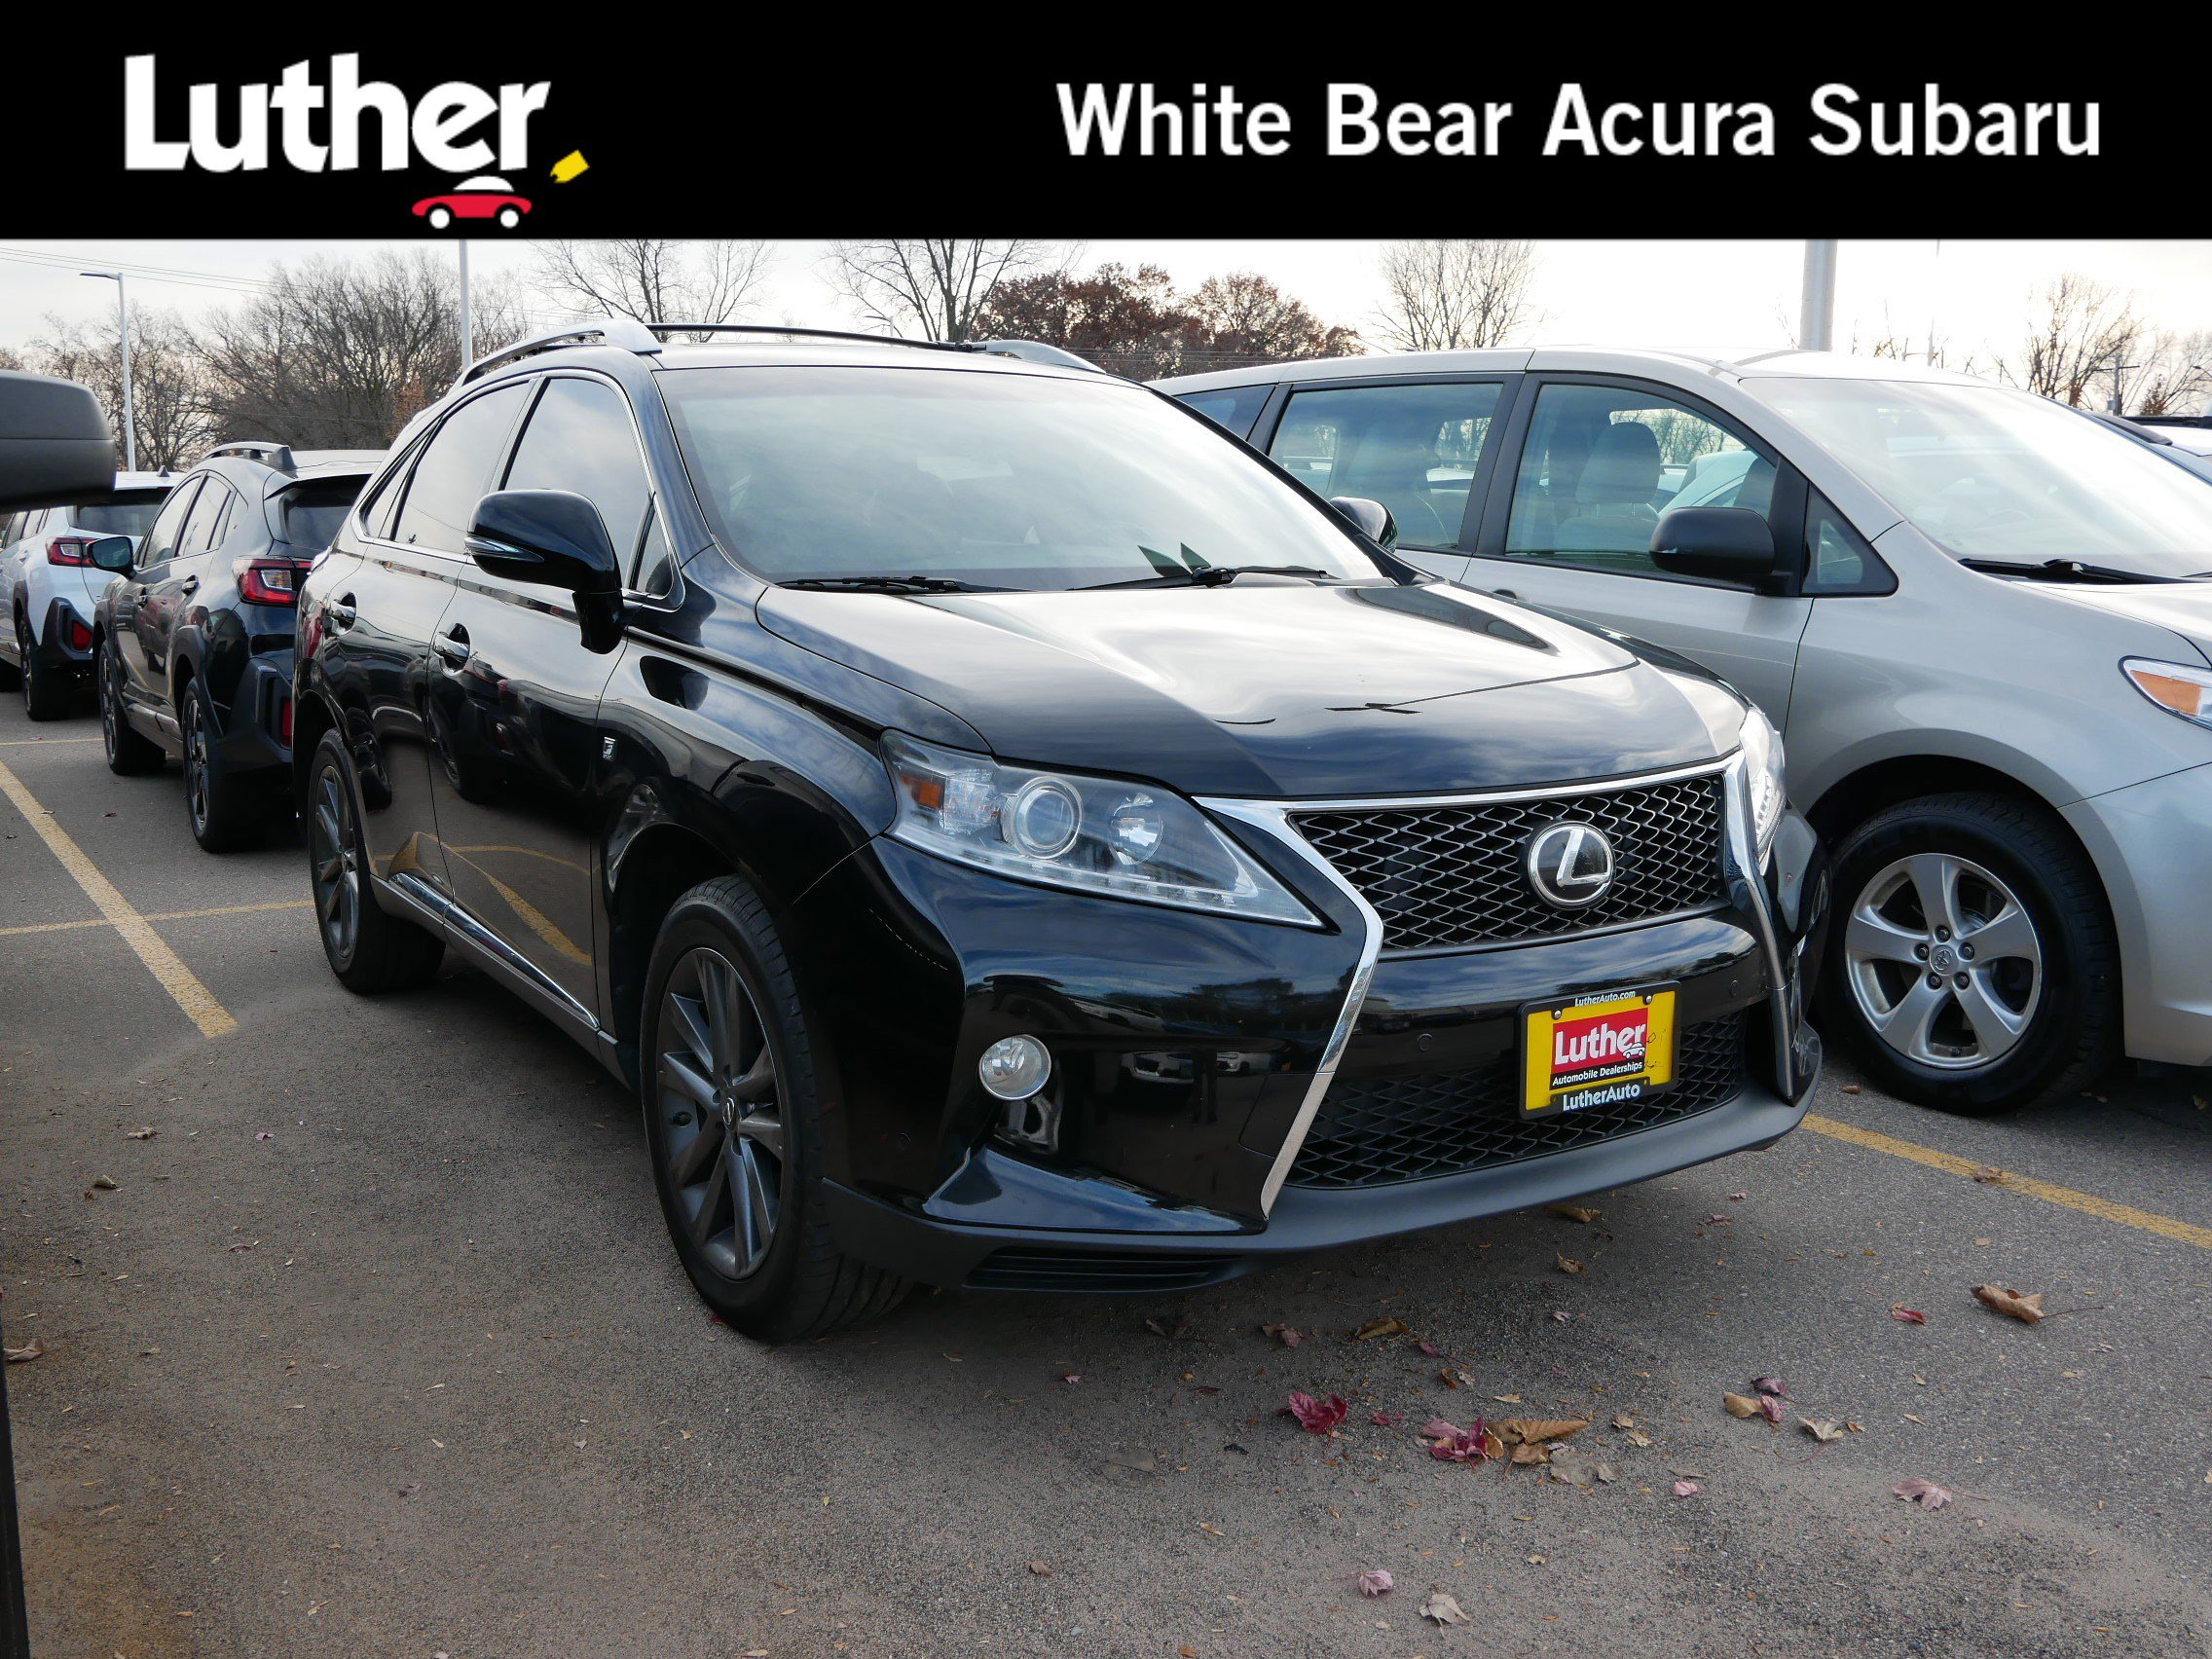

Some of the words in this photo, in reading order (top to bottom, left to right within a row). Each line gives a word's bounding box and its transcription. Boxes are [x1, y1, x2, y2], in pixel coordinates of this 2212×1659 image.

[1574, 990, 1636, 1007] LutherAuto.com
[1554, 1022, 1646, 1066] Luther
[1552, 1069, 1599, 1087] Automobile
[1600, 1060, 1642, 1077] Dealerships
[1563, 1083, 1641, 1112] LutherAuto
